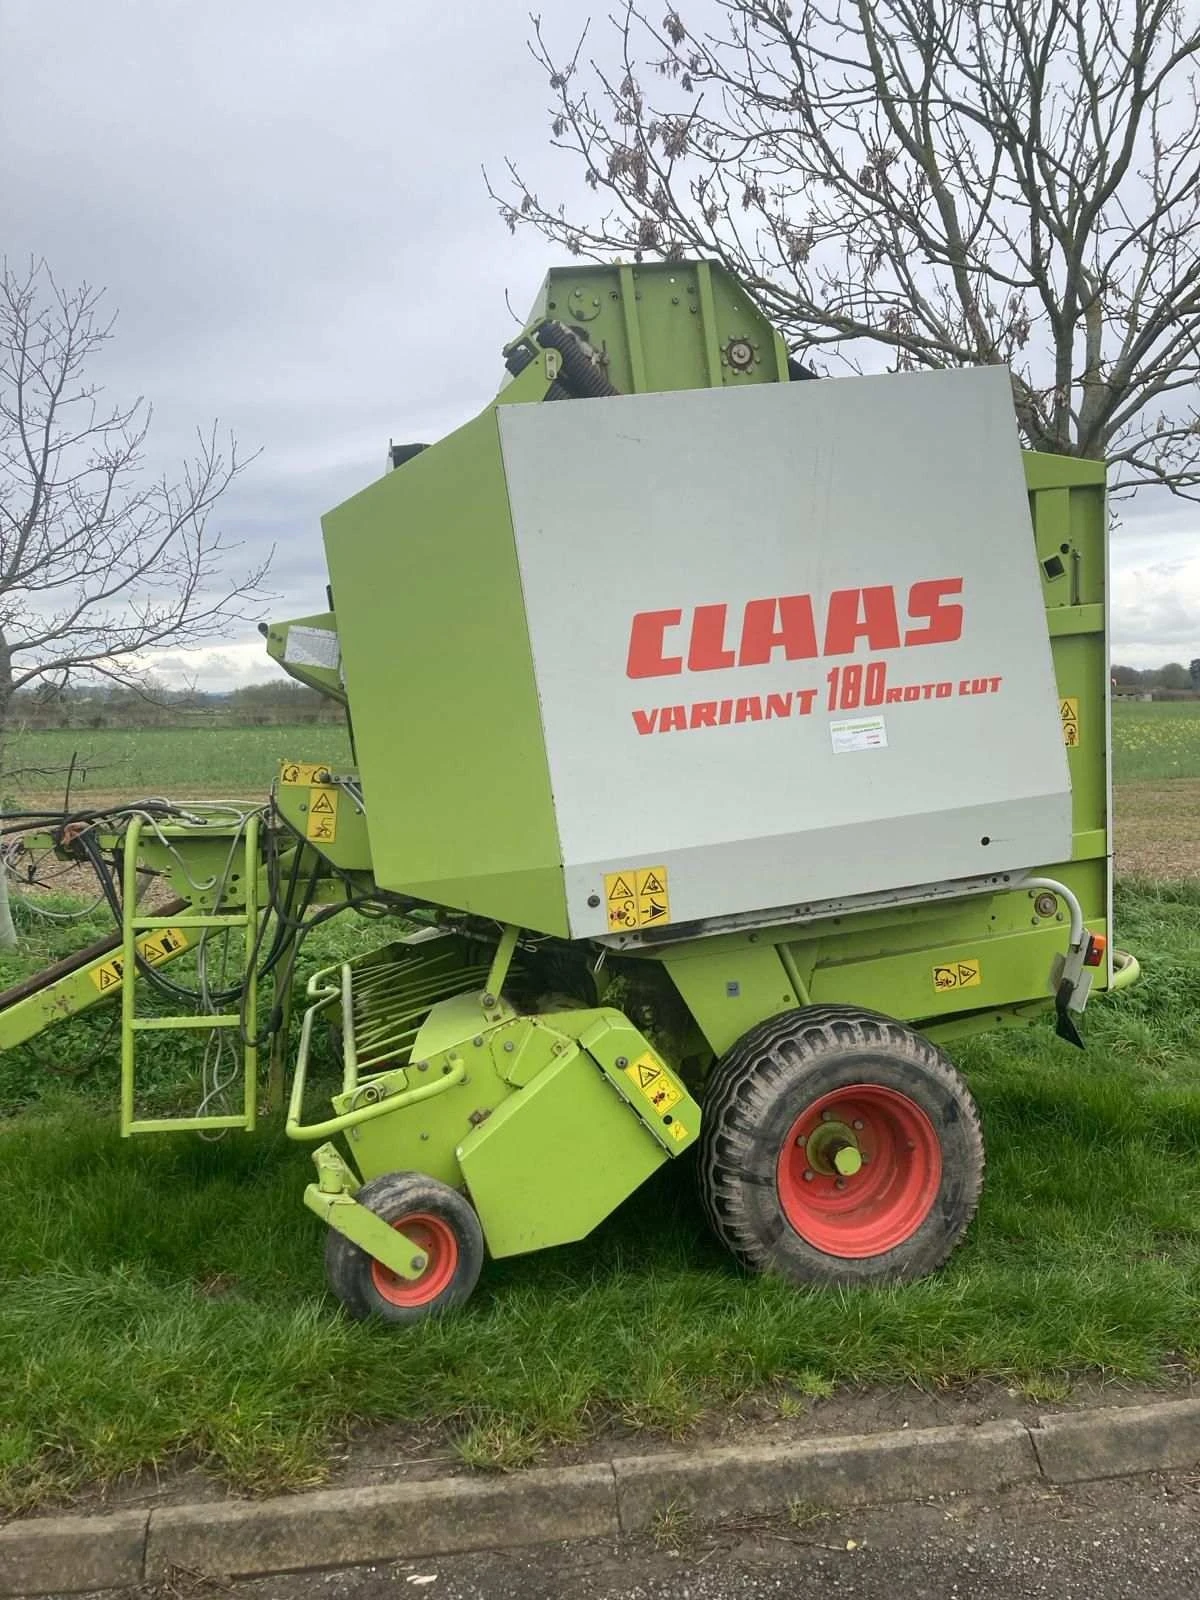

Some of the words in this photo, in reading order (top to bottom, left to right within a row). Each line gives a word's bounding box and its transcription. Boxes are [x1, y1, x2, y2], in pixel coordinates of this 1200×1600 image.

[627, 577, 964, 679] CLAAS
[632, 689, 818, 735] VARIANT
[827, 661, 886, 711] 180
[887, 682, 952, 703] ROTO
[959, 677, 1002, 696] CUT
